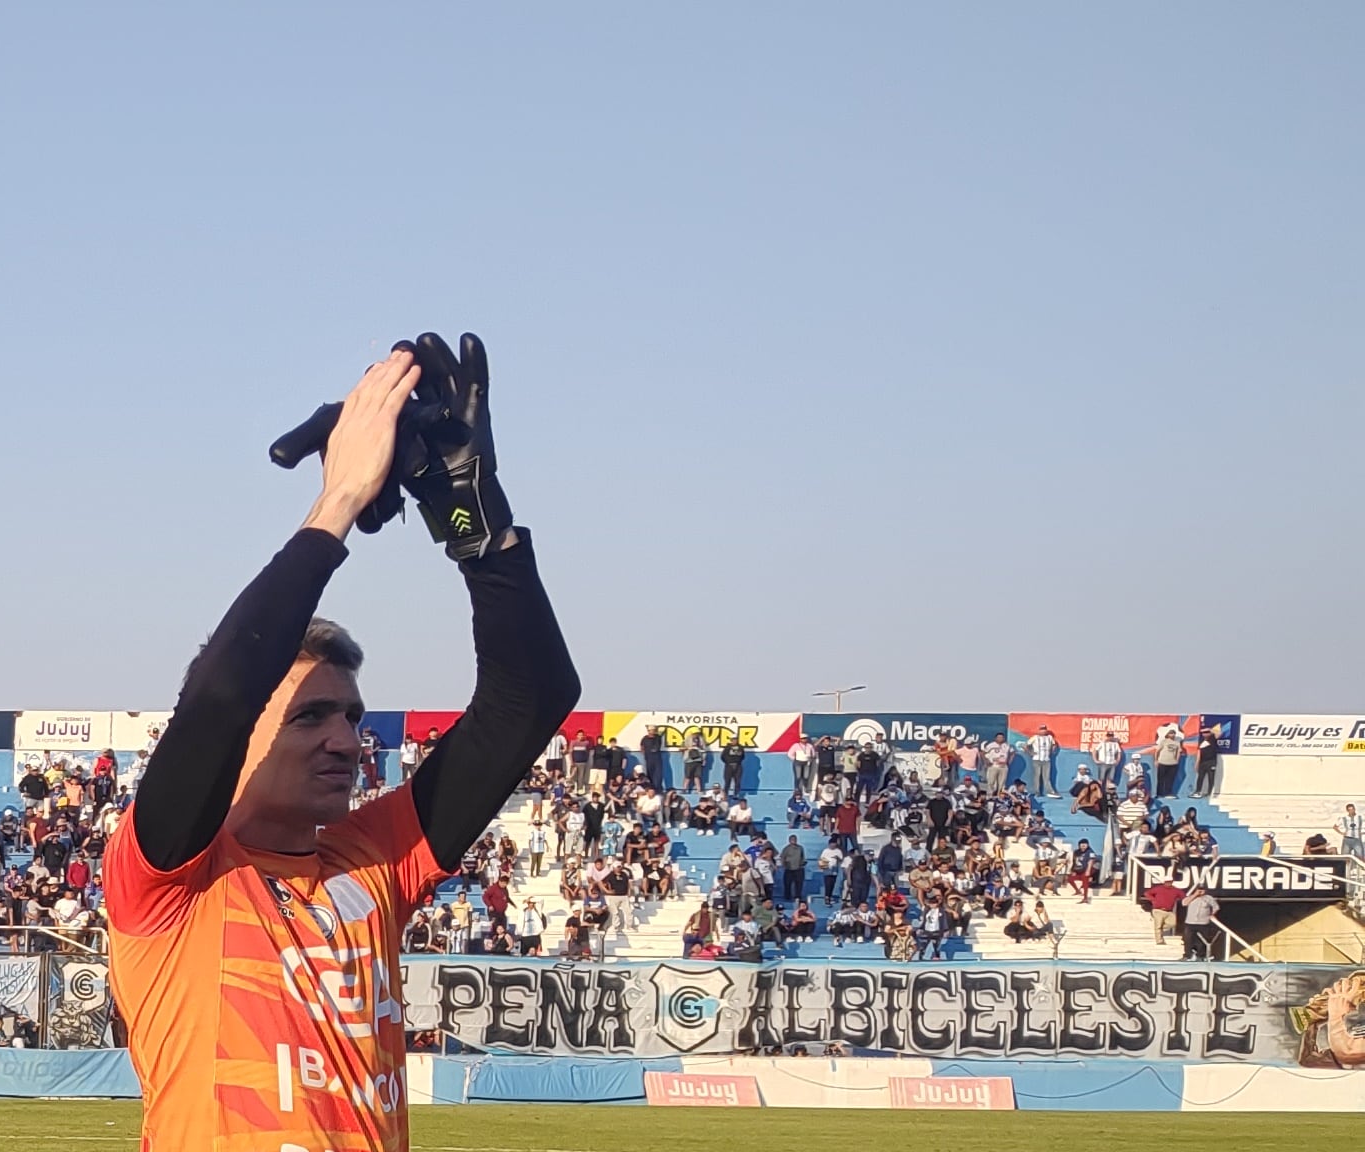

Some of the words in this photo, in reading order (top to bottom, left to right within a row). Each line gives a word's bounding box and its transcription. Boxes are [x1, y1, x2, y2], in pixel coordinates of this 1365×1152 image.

[666, 715, 739, 724] MAYORISTA
[890, 721, 967, 742] Macro
[1244, 723, 1269, 737] En
[1270, 723, 1321, 741] Jujuy
[1322, 727, 1343, 737] es
[1144, 866, 1335, 890] POWERADE
[438, 964, 636, 1052] PEÑA
[738, 967, 1261, 1057] ALBICELESTE
